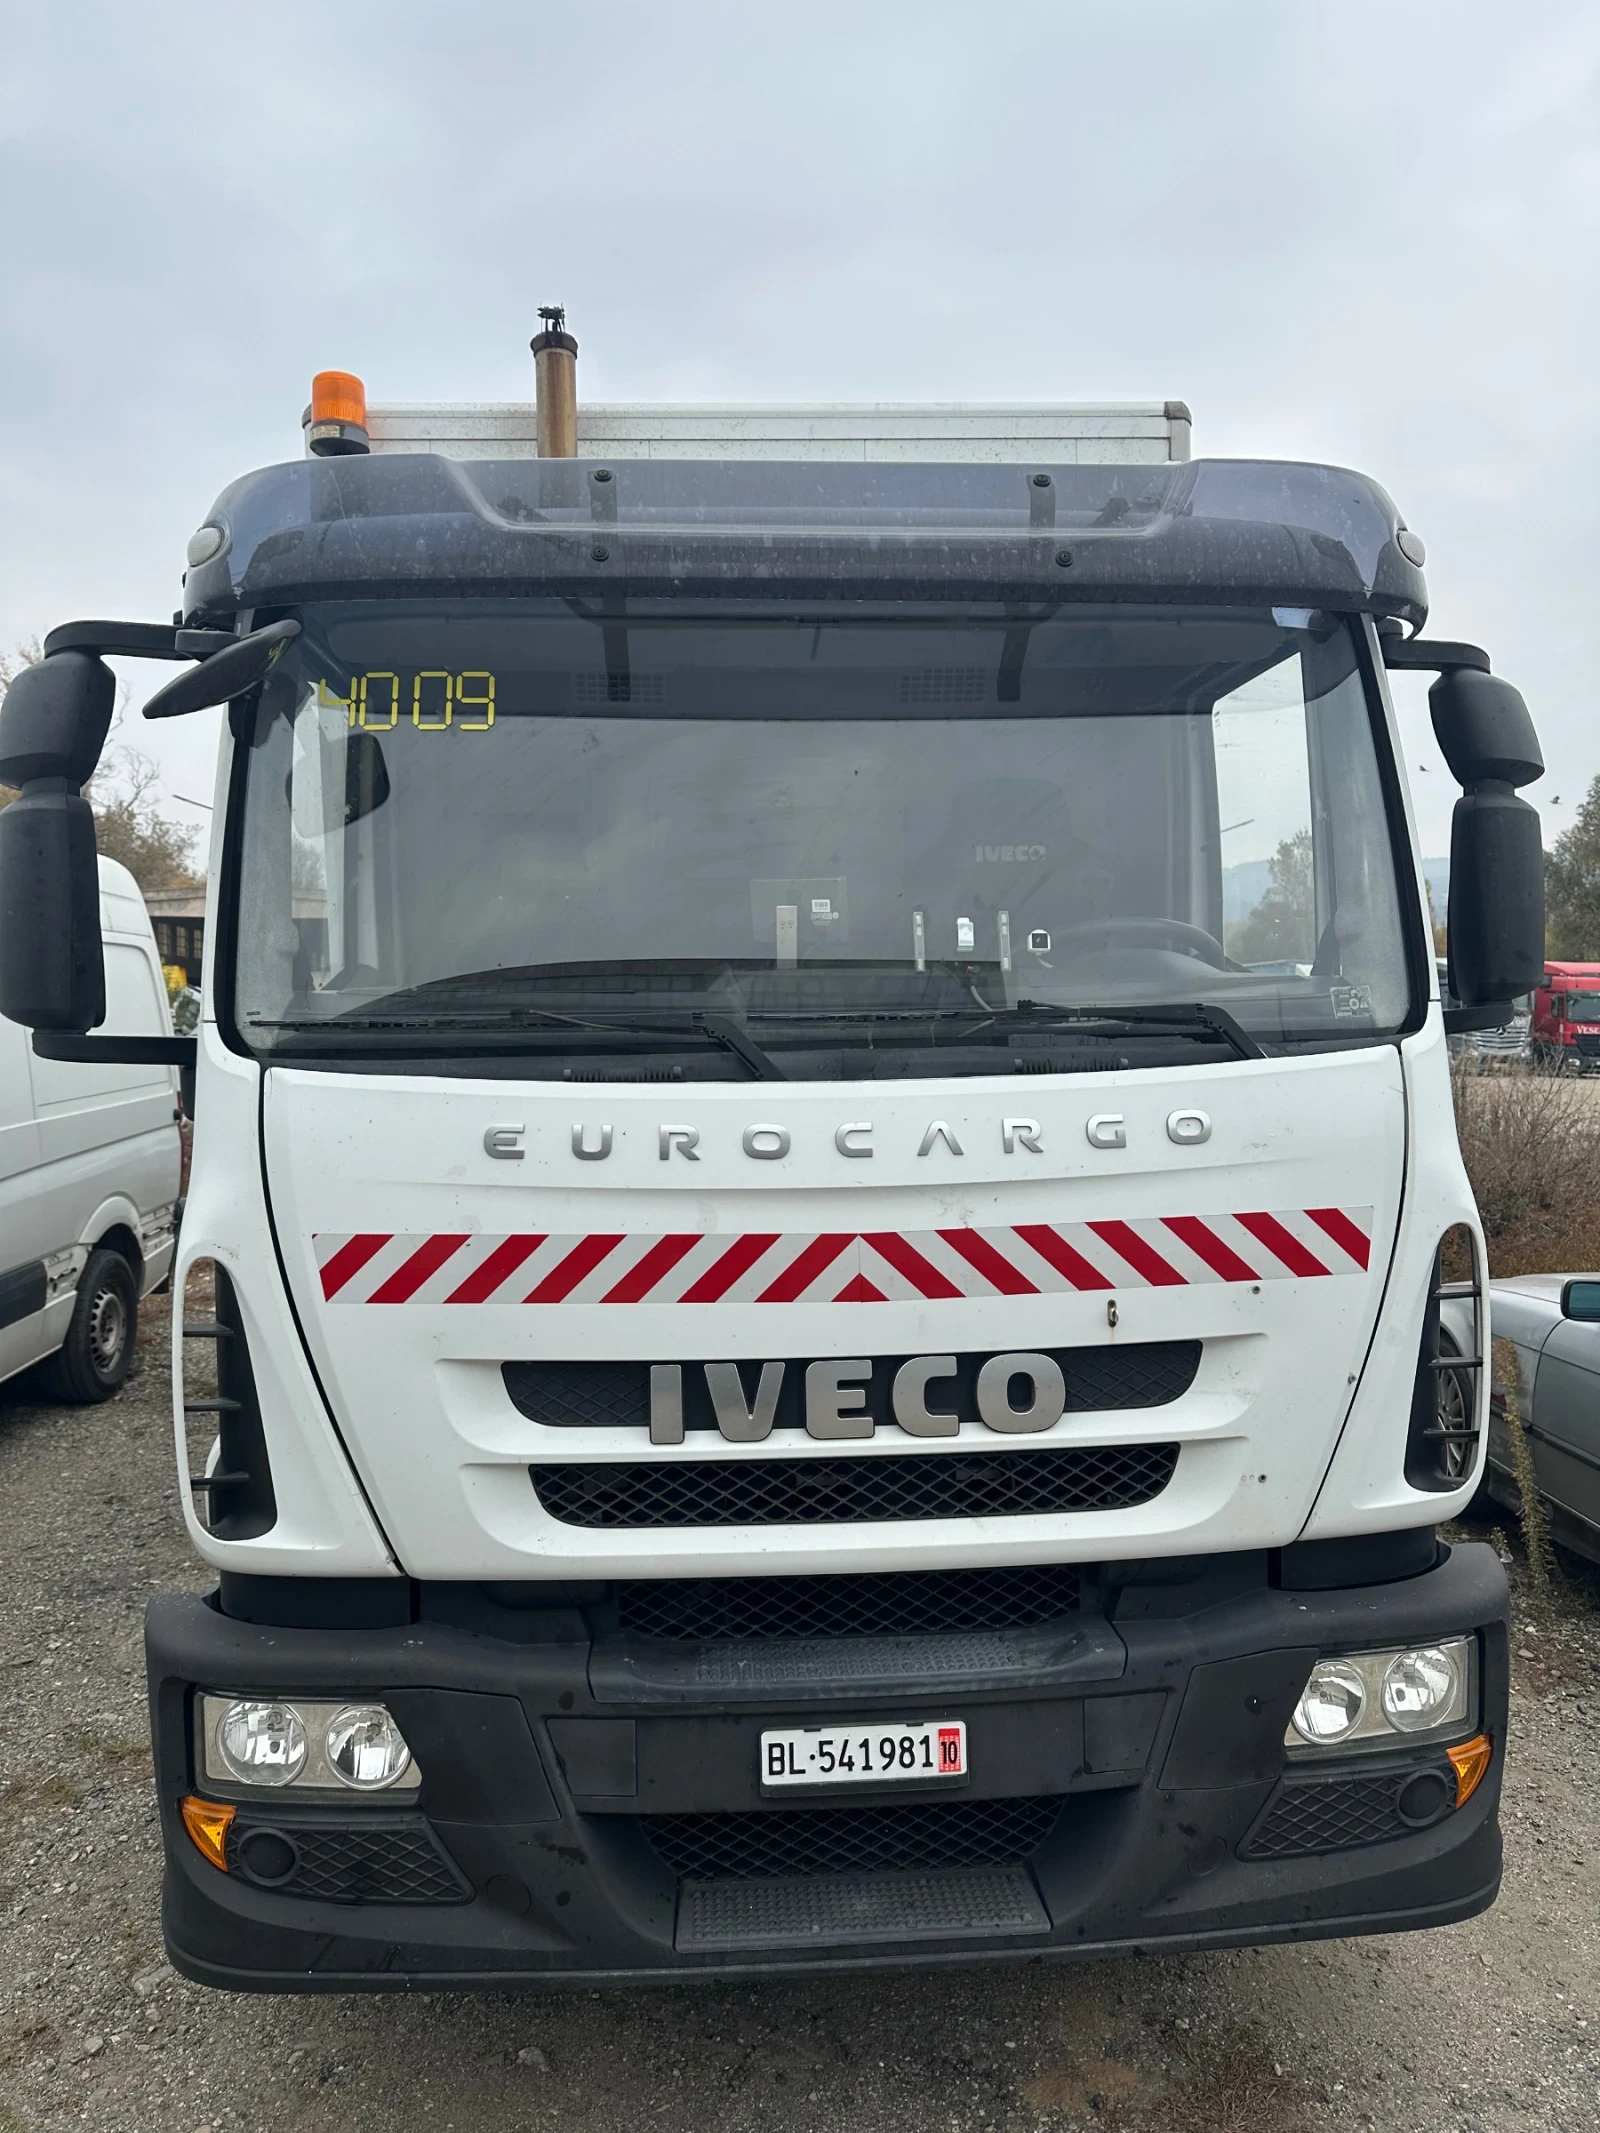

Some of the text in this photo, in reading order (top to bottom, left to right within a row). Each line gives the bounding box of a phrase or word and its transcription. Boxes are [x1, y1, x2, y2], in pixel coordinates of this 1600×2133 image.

[318, 670, 496, 731] 4009
[975, 845, 1047, 862] IVECO
[483, 1108, 1212, 1162] EUROCARGO
[648, 1352, 1067, 1445] IVECO
[940, 1740, 958, 1765] 10
